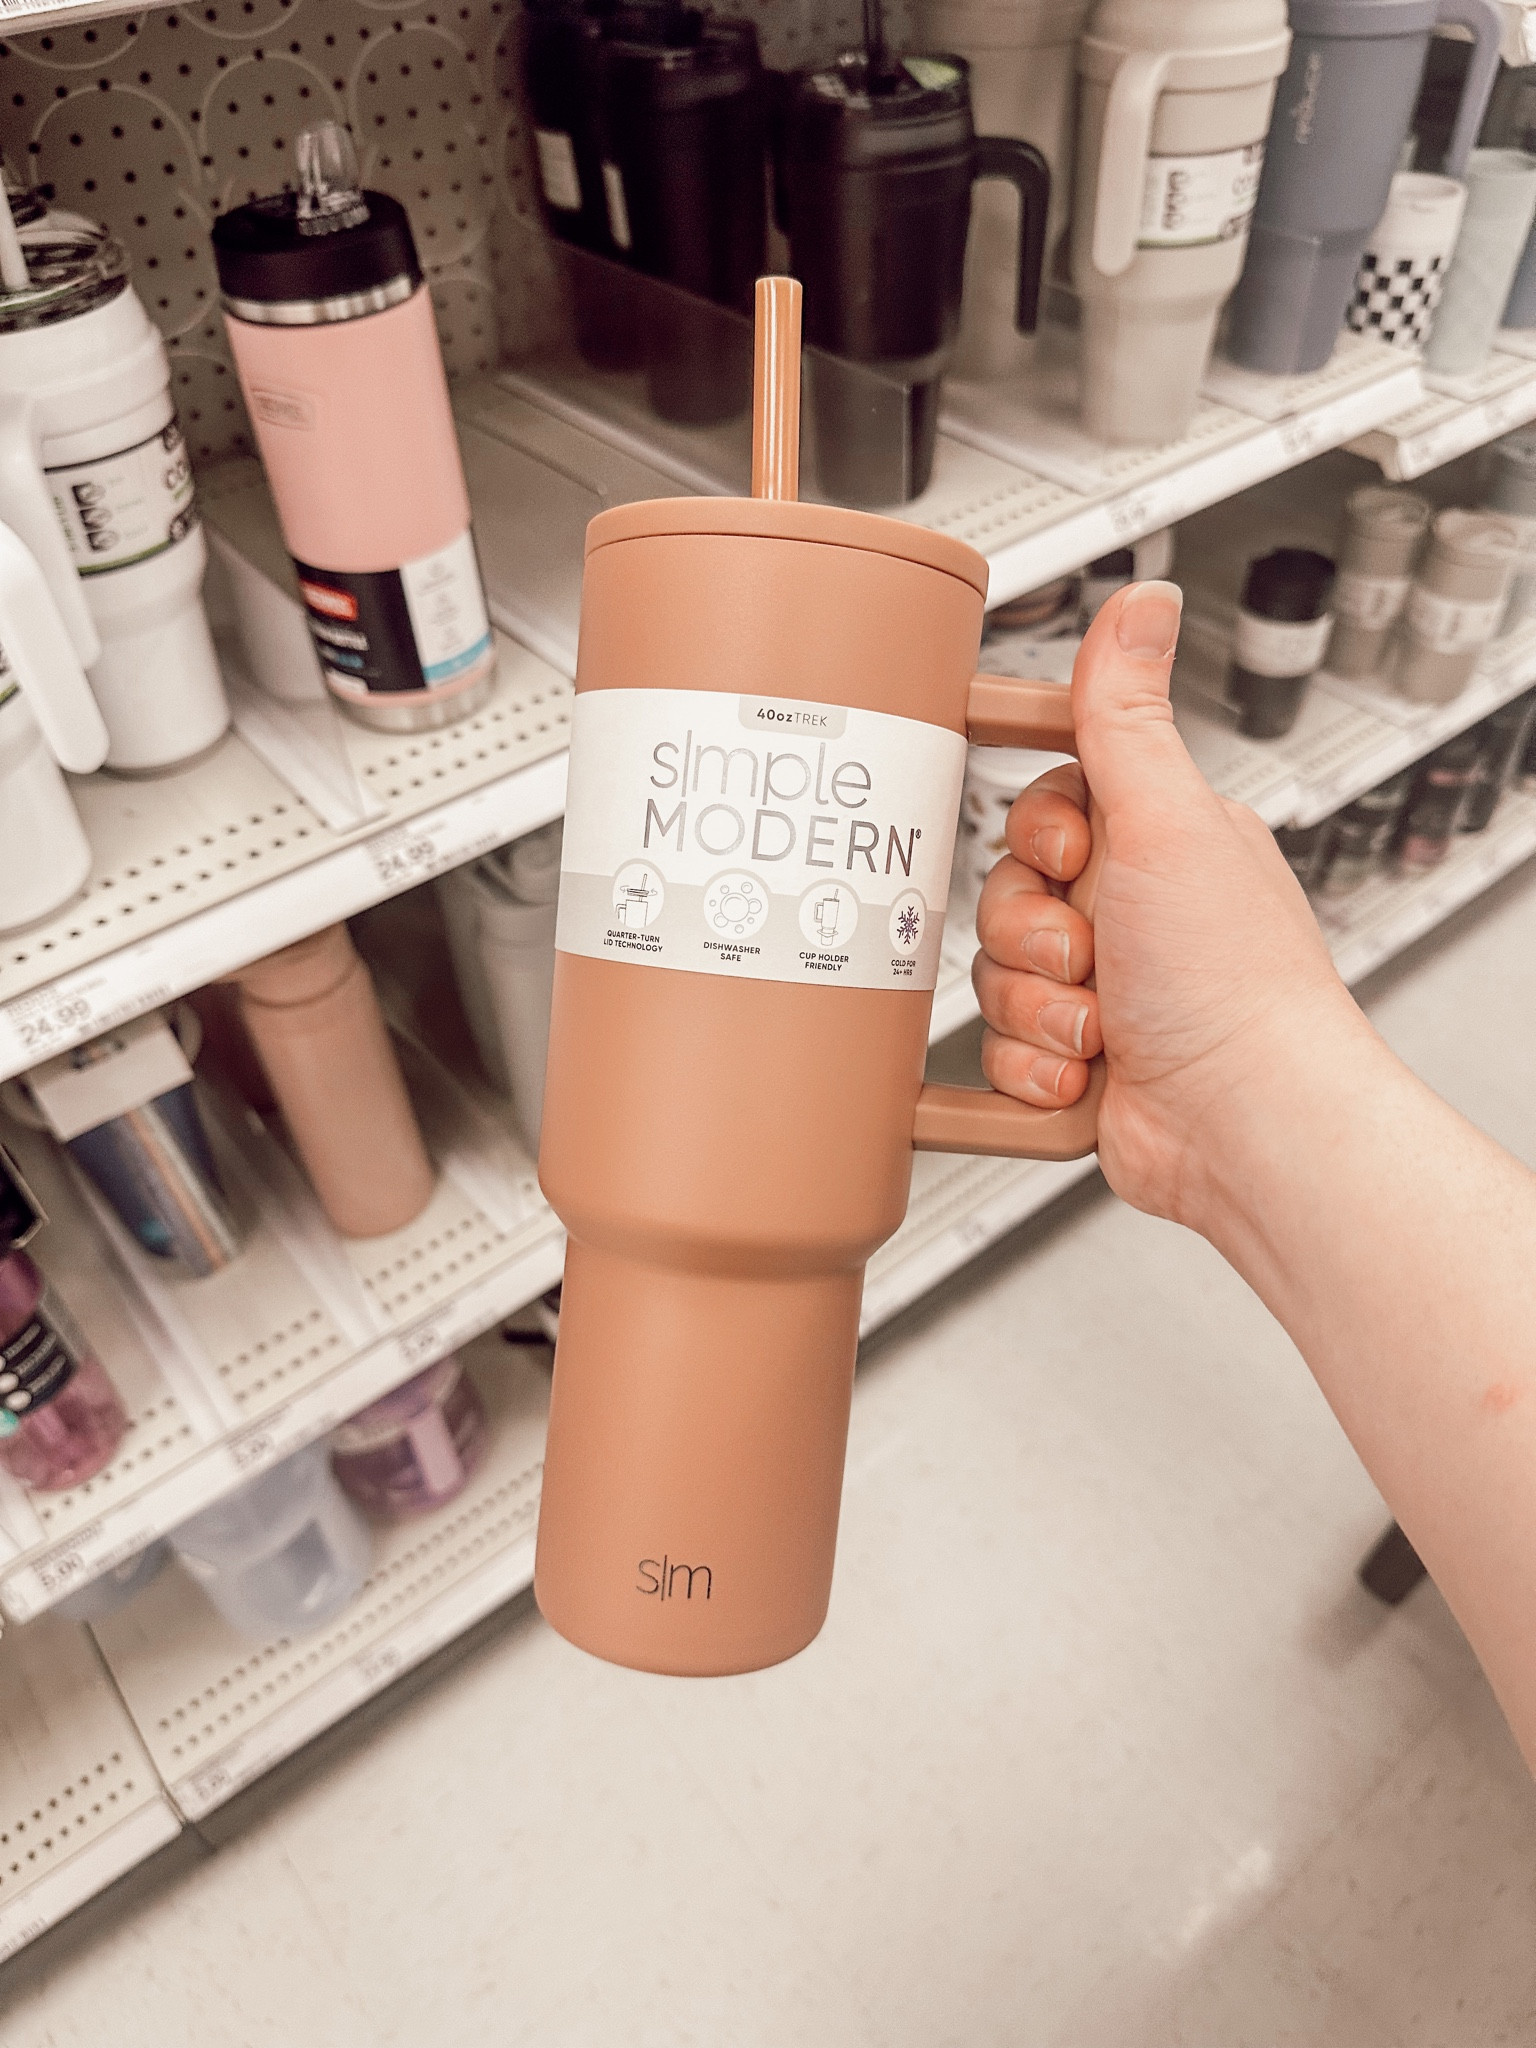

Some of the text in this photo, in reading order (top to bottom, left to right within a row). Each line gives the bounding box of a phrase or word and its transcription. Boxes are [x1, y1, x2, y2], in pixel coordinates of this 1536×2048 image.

[607, 929, 660, 943] QUARTER-TURN
[603, 938, 663, 953] LID TECHNOLOGY
[703, 941, 761, 955] DISHWASHER
[720, 952, 742, 962] SAFE
[799, 952, 849, 963] CUP HOLDER
[804, 962, 842, 971] FRIENDLY
[891, 959, 916, 968] COLD FOR
[19, 998, 91, 1047] 24.99
